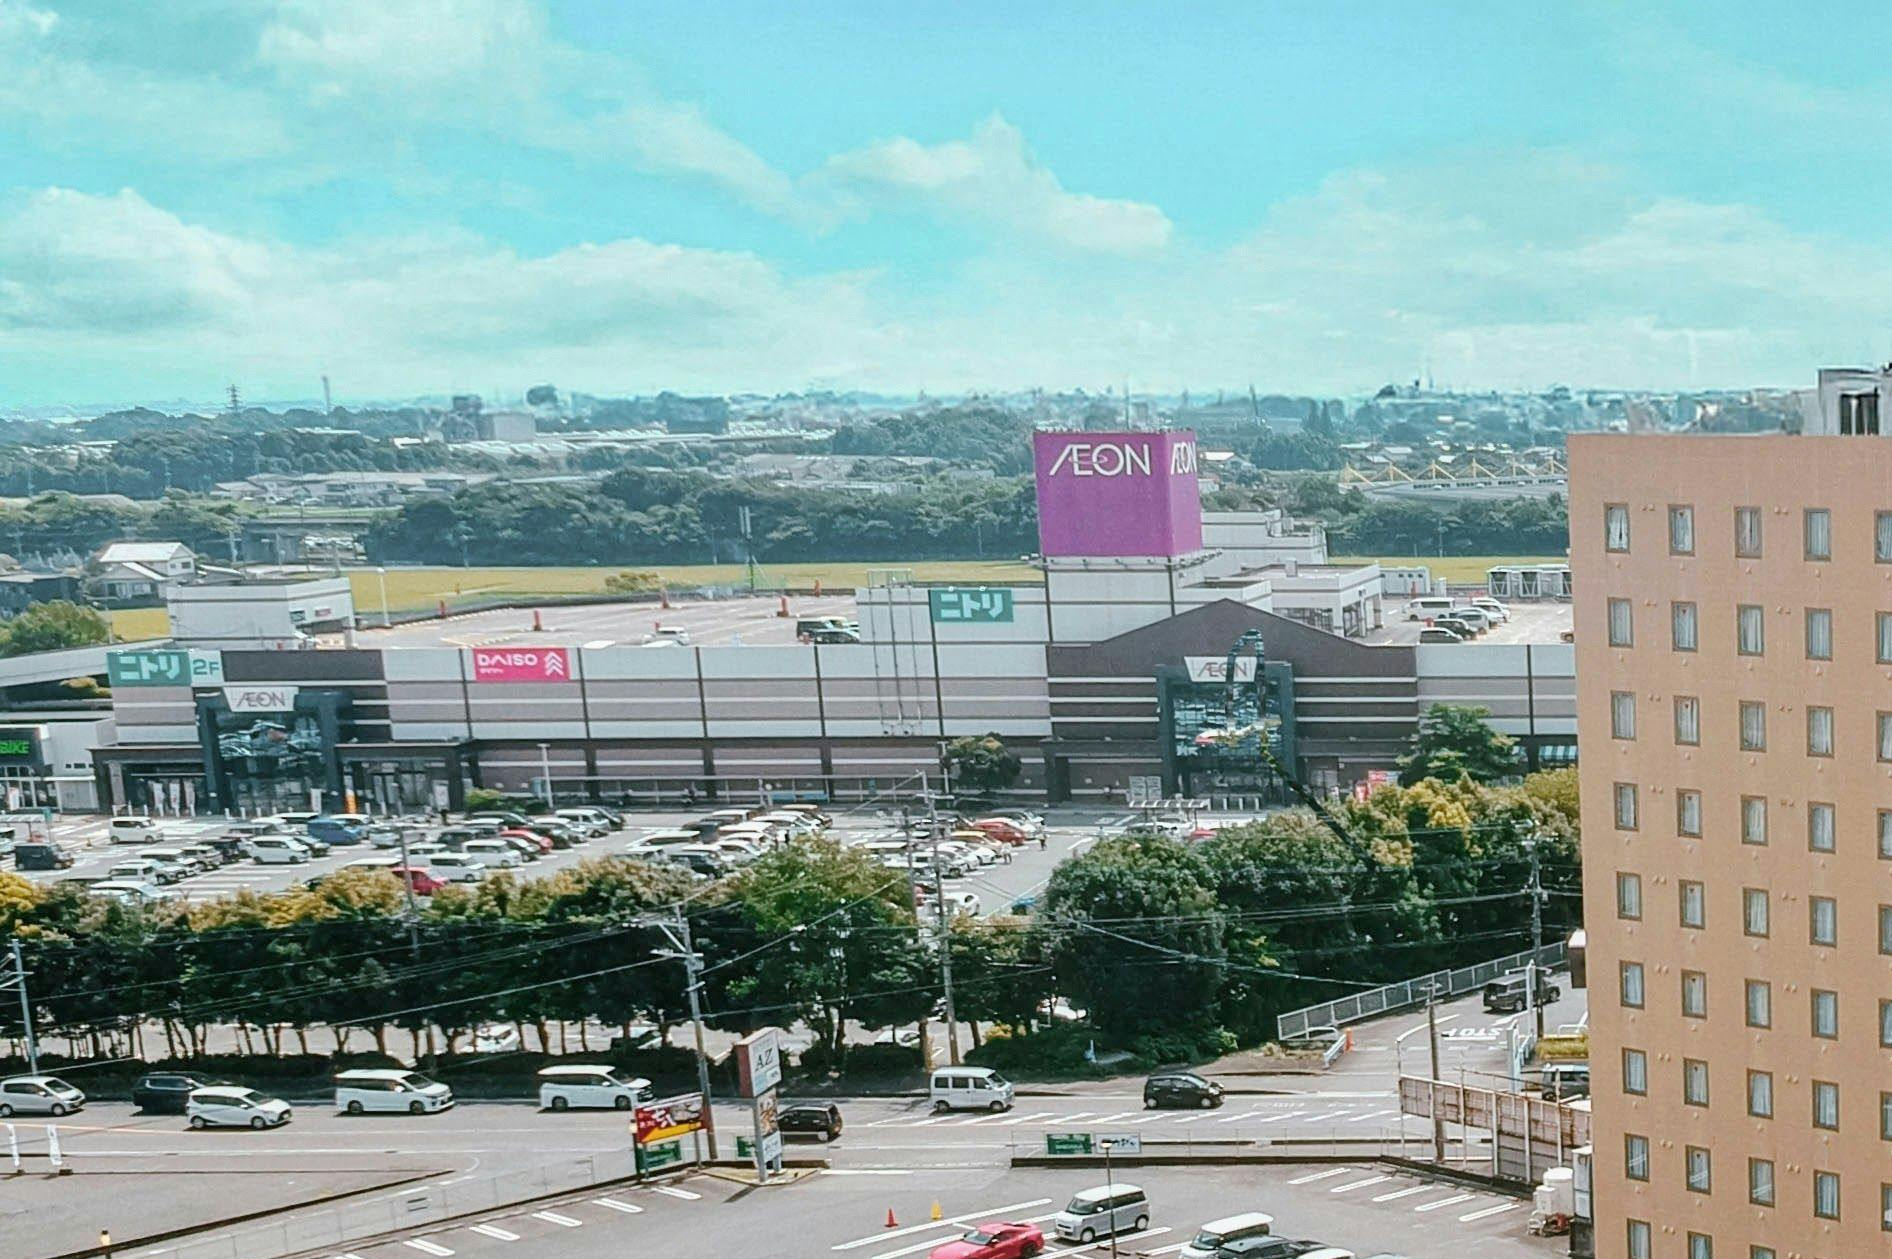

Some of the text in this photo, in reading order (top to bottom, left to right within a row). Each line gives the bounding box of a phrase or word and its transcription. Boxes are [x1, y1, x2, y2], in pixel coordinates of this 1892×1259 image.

[941, 593, 1004, 618] ニトリ
[120, 655, 220, 680] ニトリ 2F
[477, 653, 538, 667] DAISO
